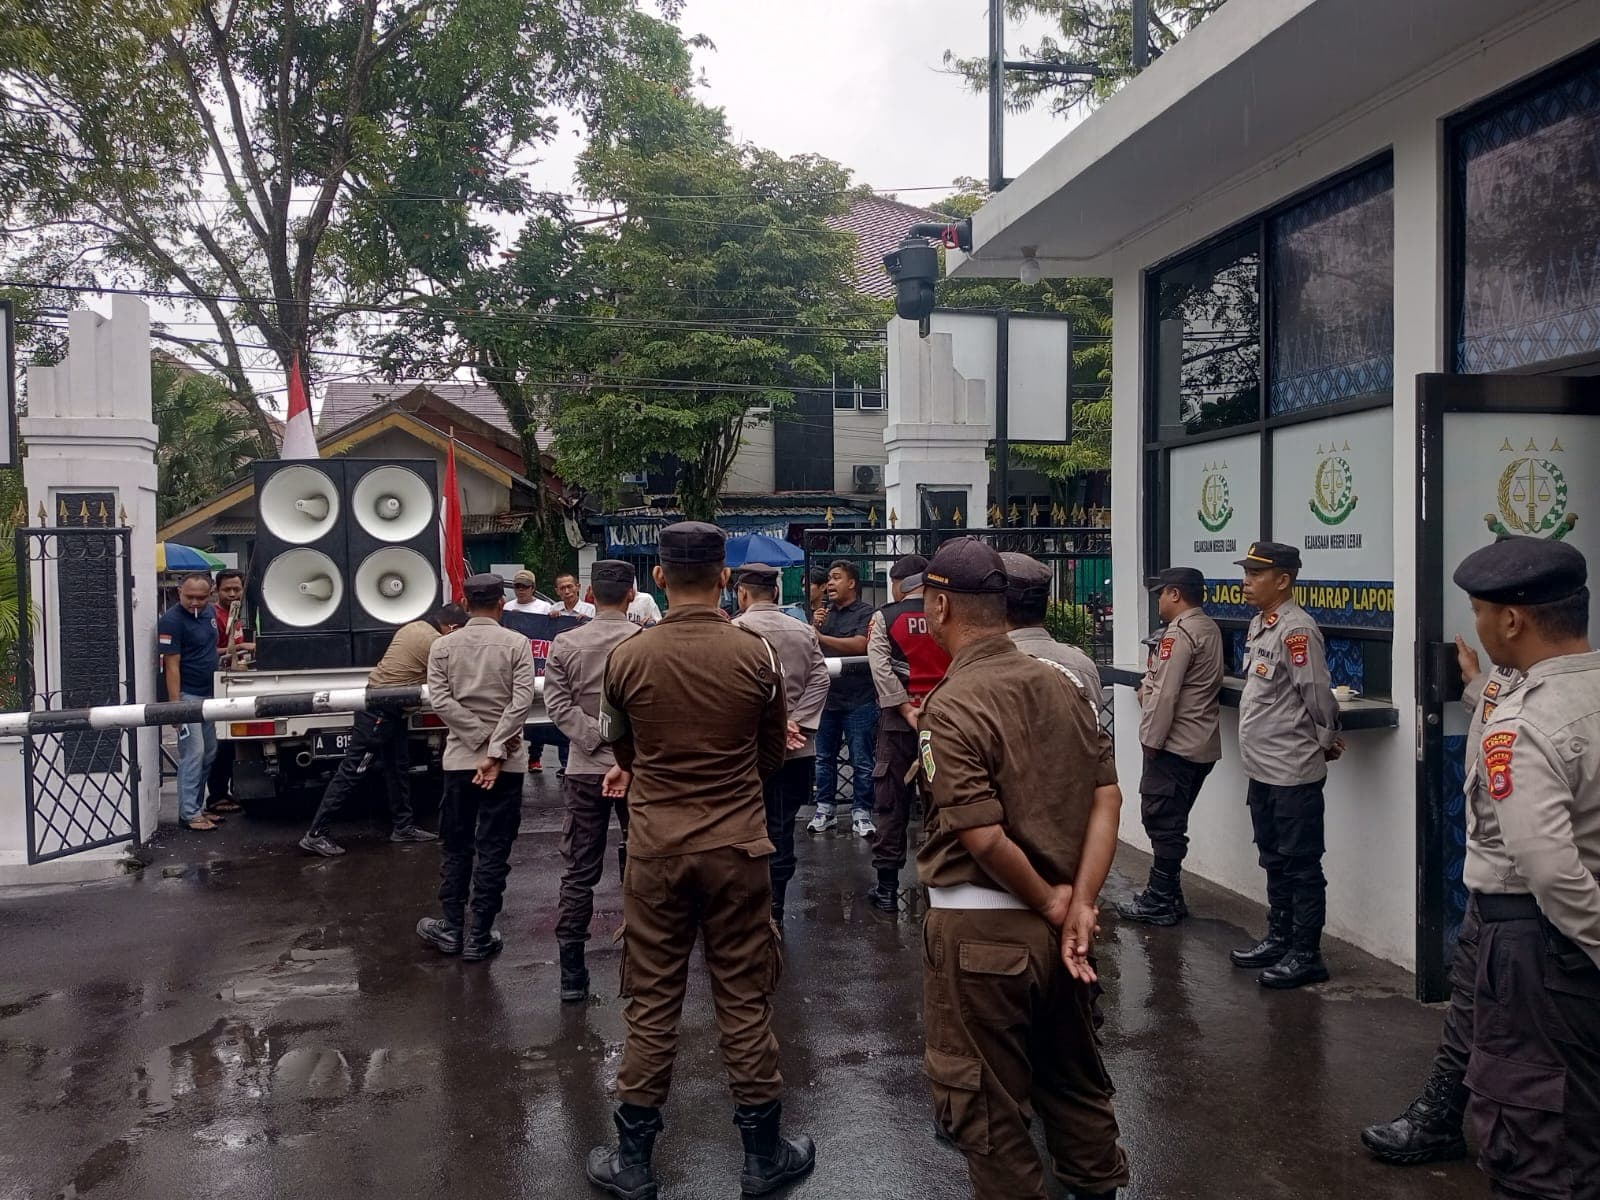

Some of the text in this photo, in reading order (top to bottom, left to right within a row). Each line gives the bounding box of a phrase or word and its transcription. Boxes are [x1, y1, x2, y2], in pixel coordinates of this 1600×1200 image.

[1305, 533, 1362, 550] KEJAKSAAN NEGERI LEBAK
[1310, 586, 1349, 609] HARAP
[316, 736, 324, 749] A
